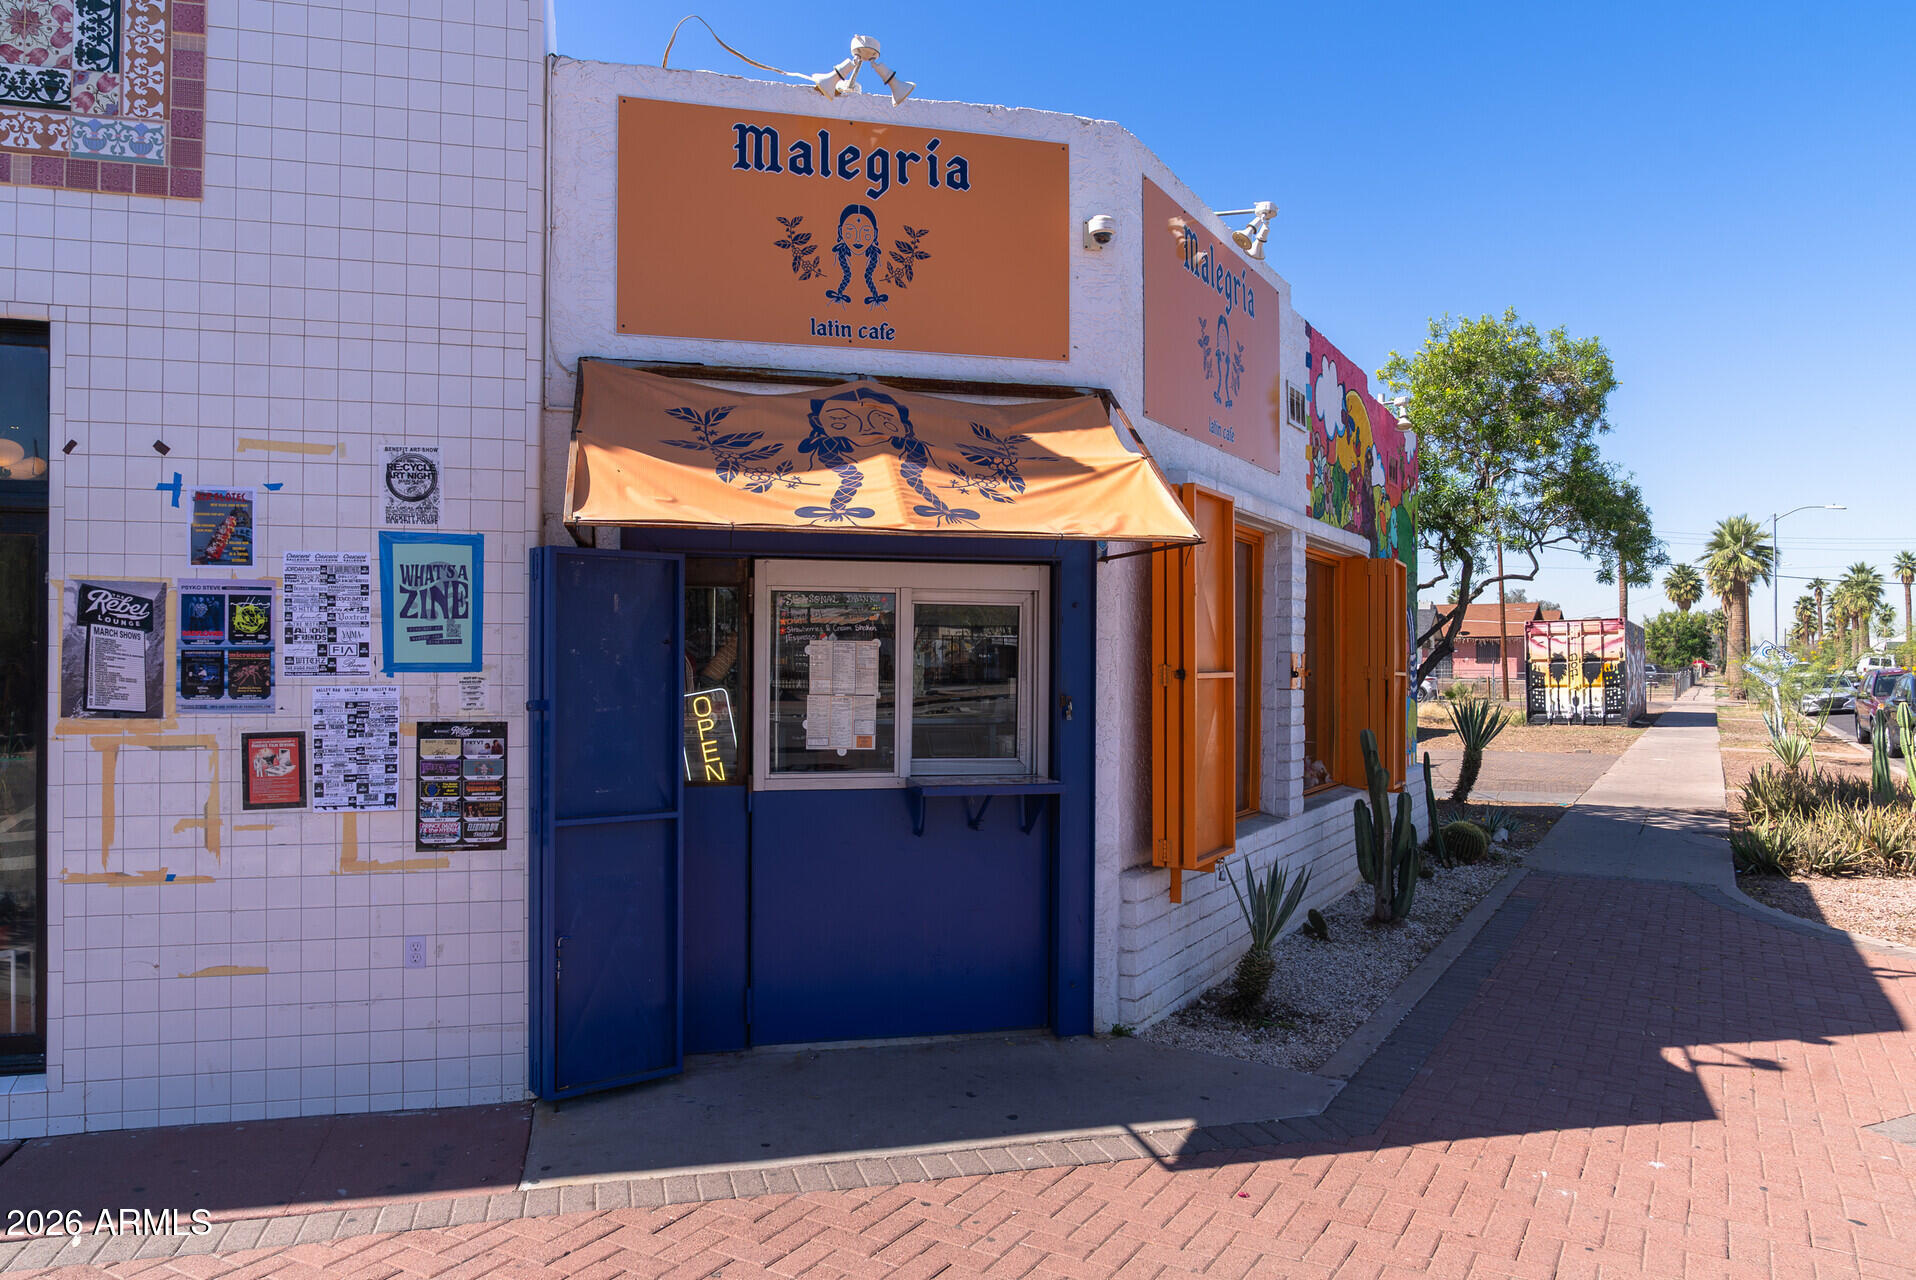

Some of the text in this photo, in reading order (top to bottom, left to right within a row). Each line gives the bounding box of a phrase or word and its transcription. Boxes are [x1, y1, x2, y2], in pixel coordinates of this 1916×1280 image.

[732, 122, 971, 201] Malegría
[1184, 224, 1255, 320] Malegría
[810, 317, 896, 341] latin cafe
[407, 472, 435, 480] NIGHT
[400, 564, 469, 586] WHAT'S A
[85, 589, 150, 620] Rebel
[399, 581, 469, 619] ZINE
[93, 626, 142, 640] MARCH SHOWS
[97, 615, 141, 627] LOUNGE
[693, 696, 725, 781] OPEN
